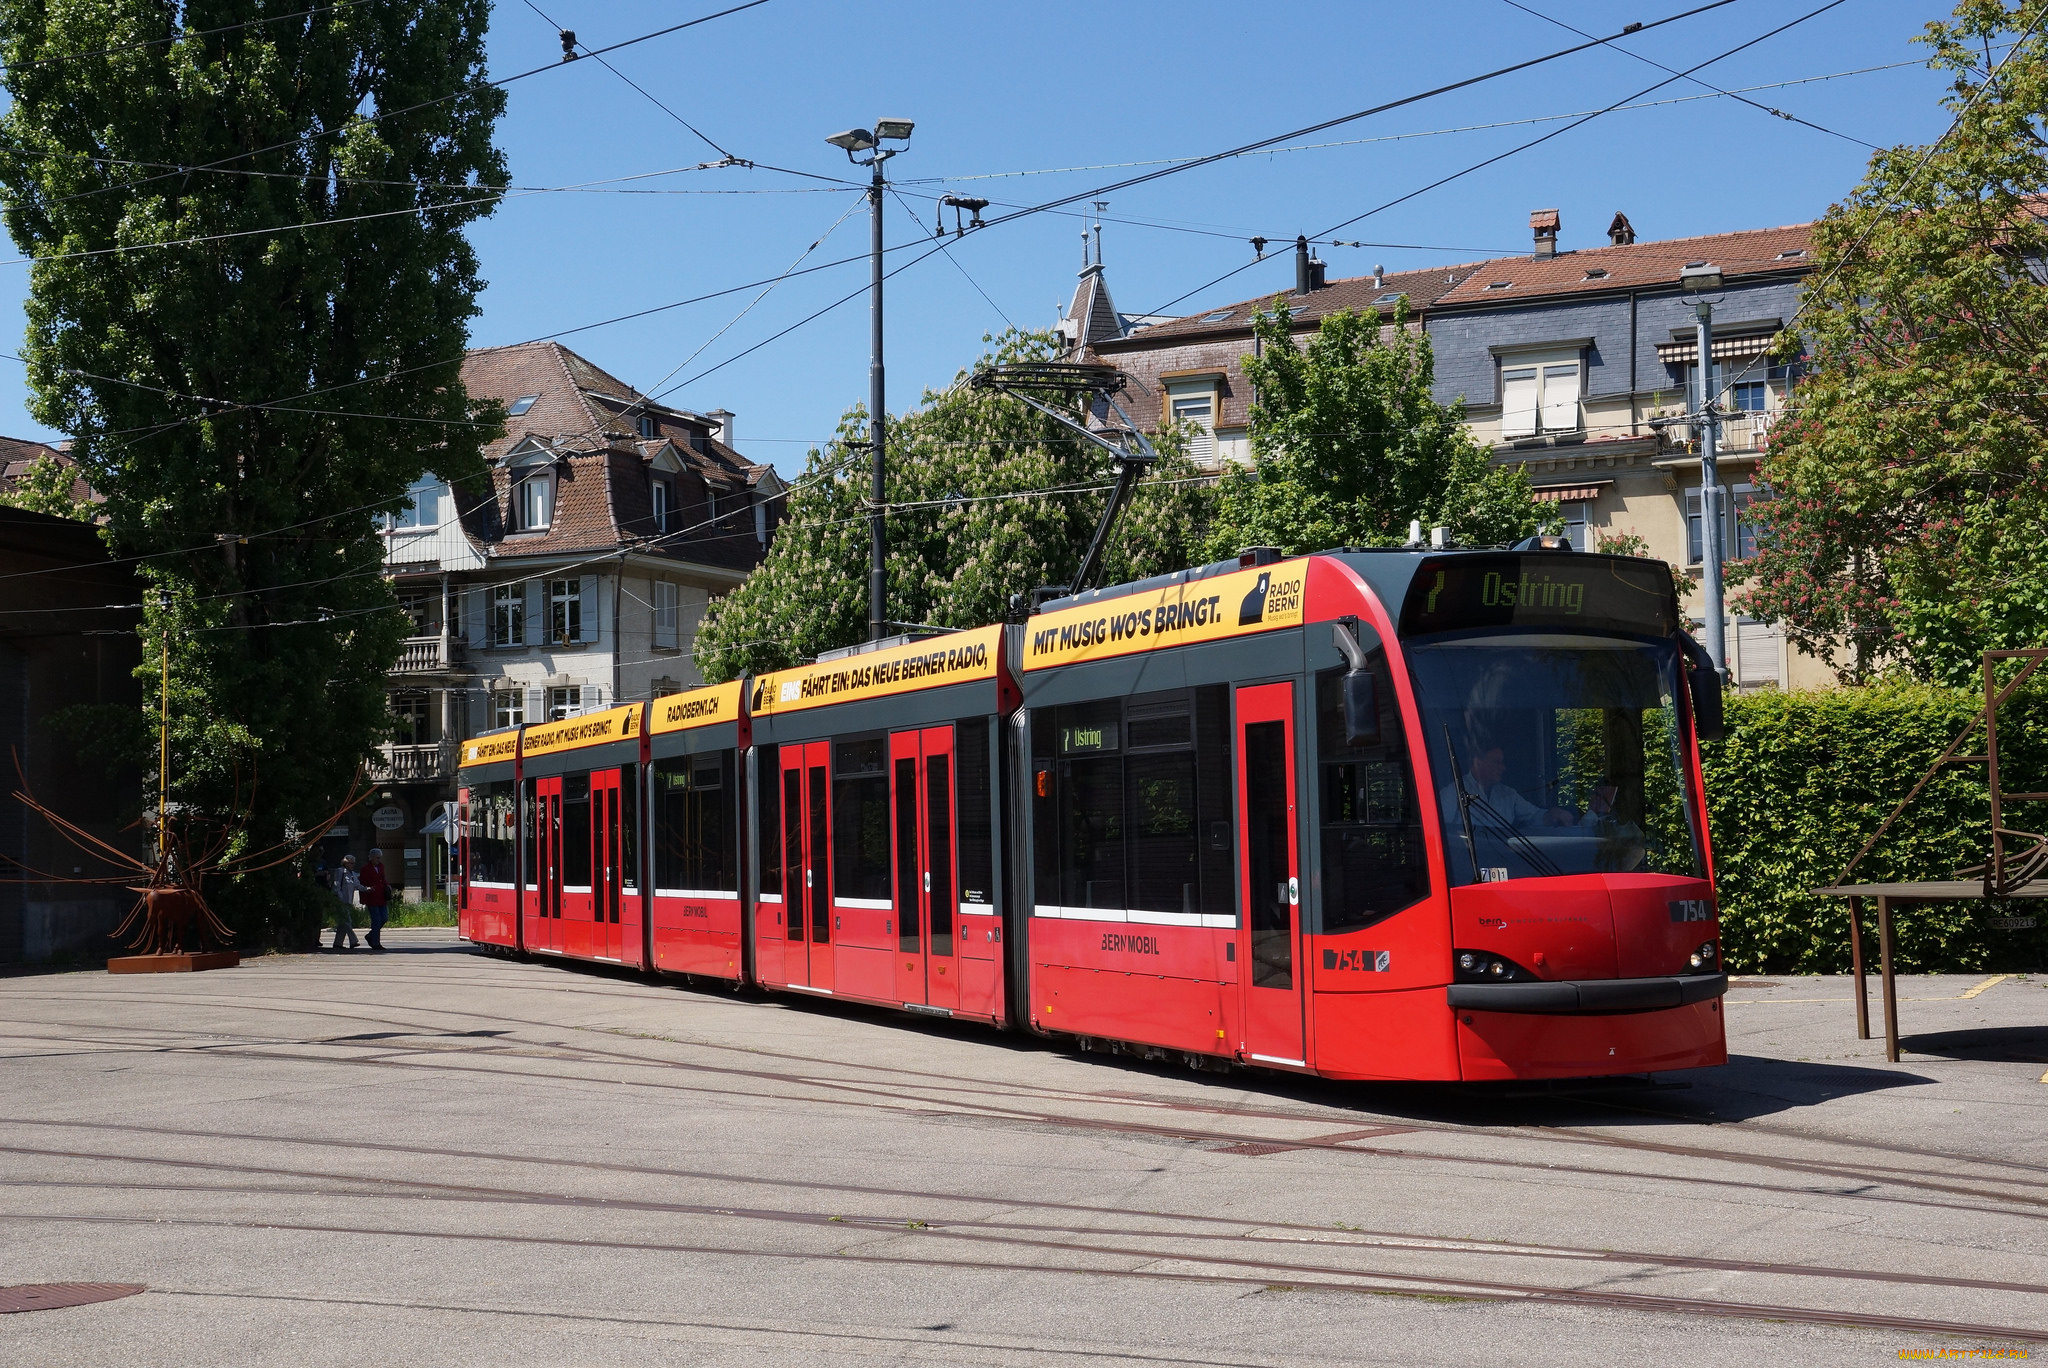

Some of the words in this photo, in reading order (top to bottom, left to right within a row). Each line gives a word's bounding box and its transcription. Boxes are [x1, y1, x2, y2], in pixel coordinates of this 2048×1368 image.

[1270, 579, 1301, 598] RADIO
[1482, 572, 1584, 614] Ostring
[1033, 627, 1058, 656] MIT
[1059, 618, 1106, 651] MUSIG
[1110, 610, 1152, 642] WO'S
[1154, 595, 1222, 634] BRINGT.
[780, 679, 801, 702] EINS
[801, 673, 831, 699] FÄHRT
[831, 675, 850, 693] EIN:
[850, 667, 870, 688] DAS
[872, 661, 900, 685] NEUE
[902, 651, 947, 681] BERNER
[948, 643, 988, 672] RADIO,
[764, 685, 777, 695] RADIO
[523, 733, 541, 751] BERNER
[556, 729, 565, 745] MIT
[564, 726, 579, 742] MUSIG
[592, 719, 613, 738] BRINGT.
[504, 740, 516, 754] NEUE
[1479, 917, 1502, 925] bern
[1679, 899, 1707, 922] 754
[1333, 949, 1365, 971] 754
